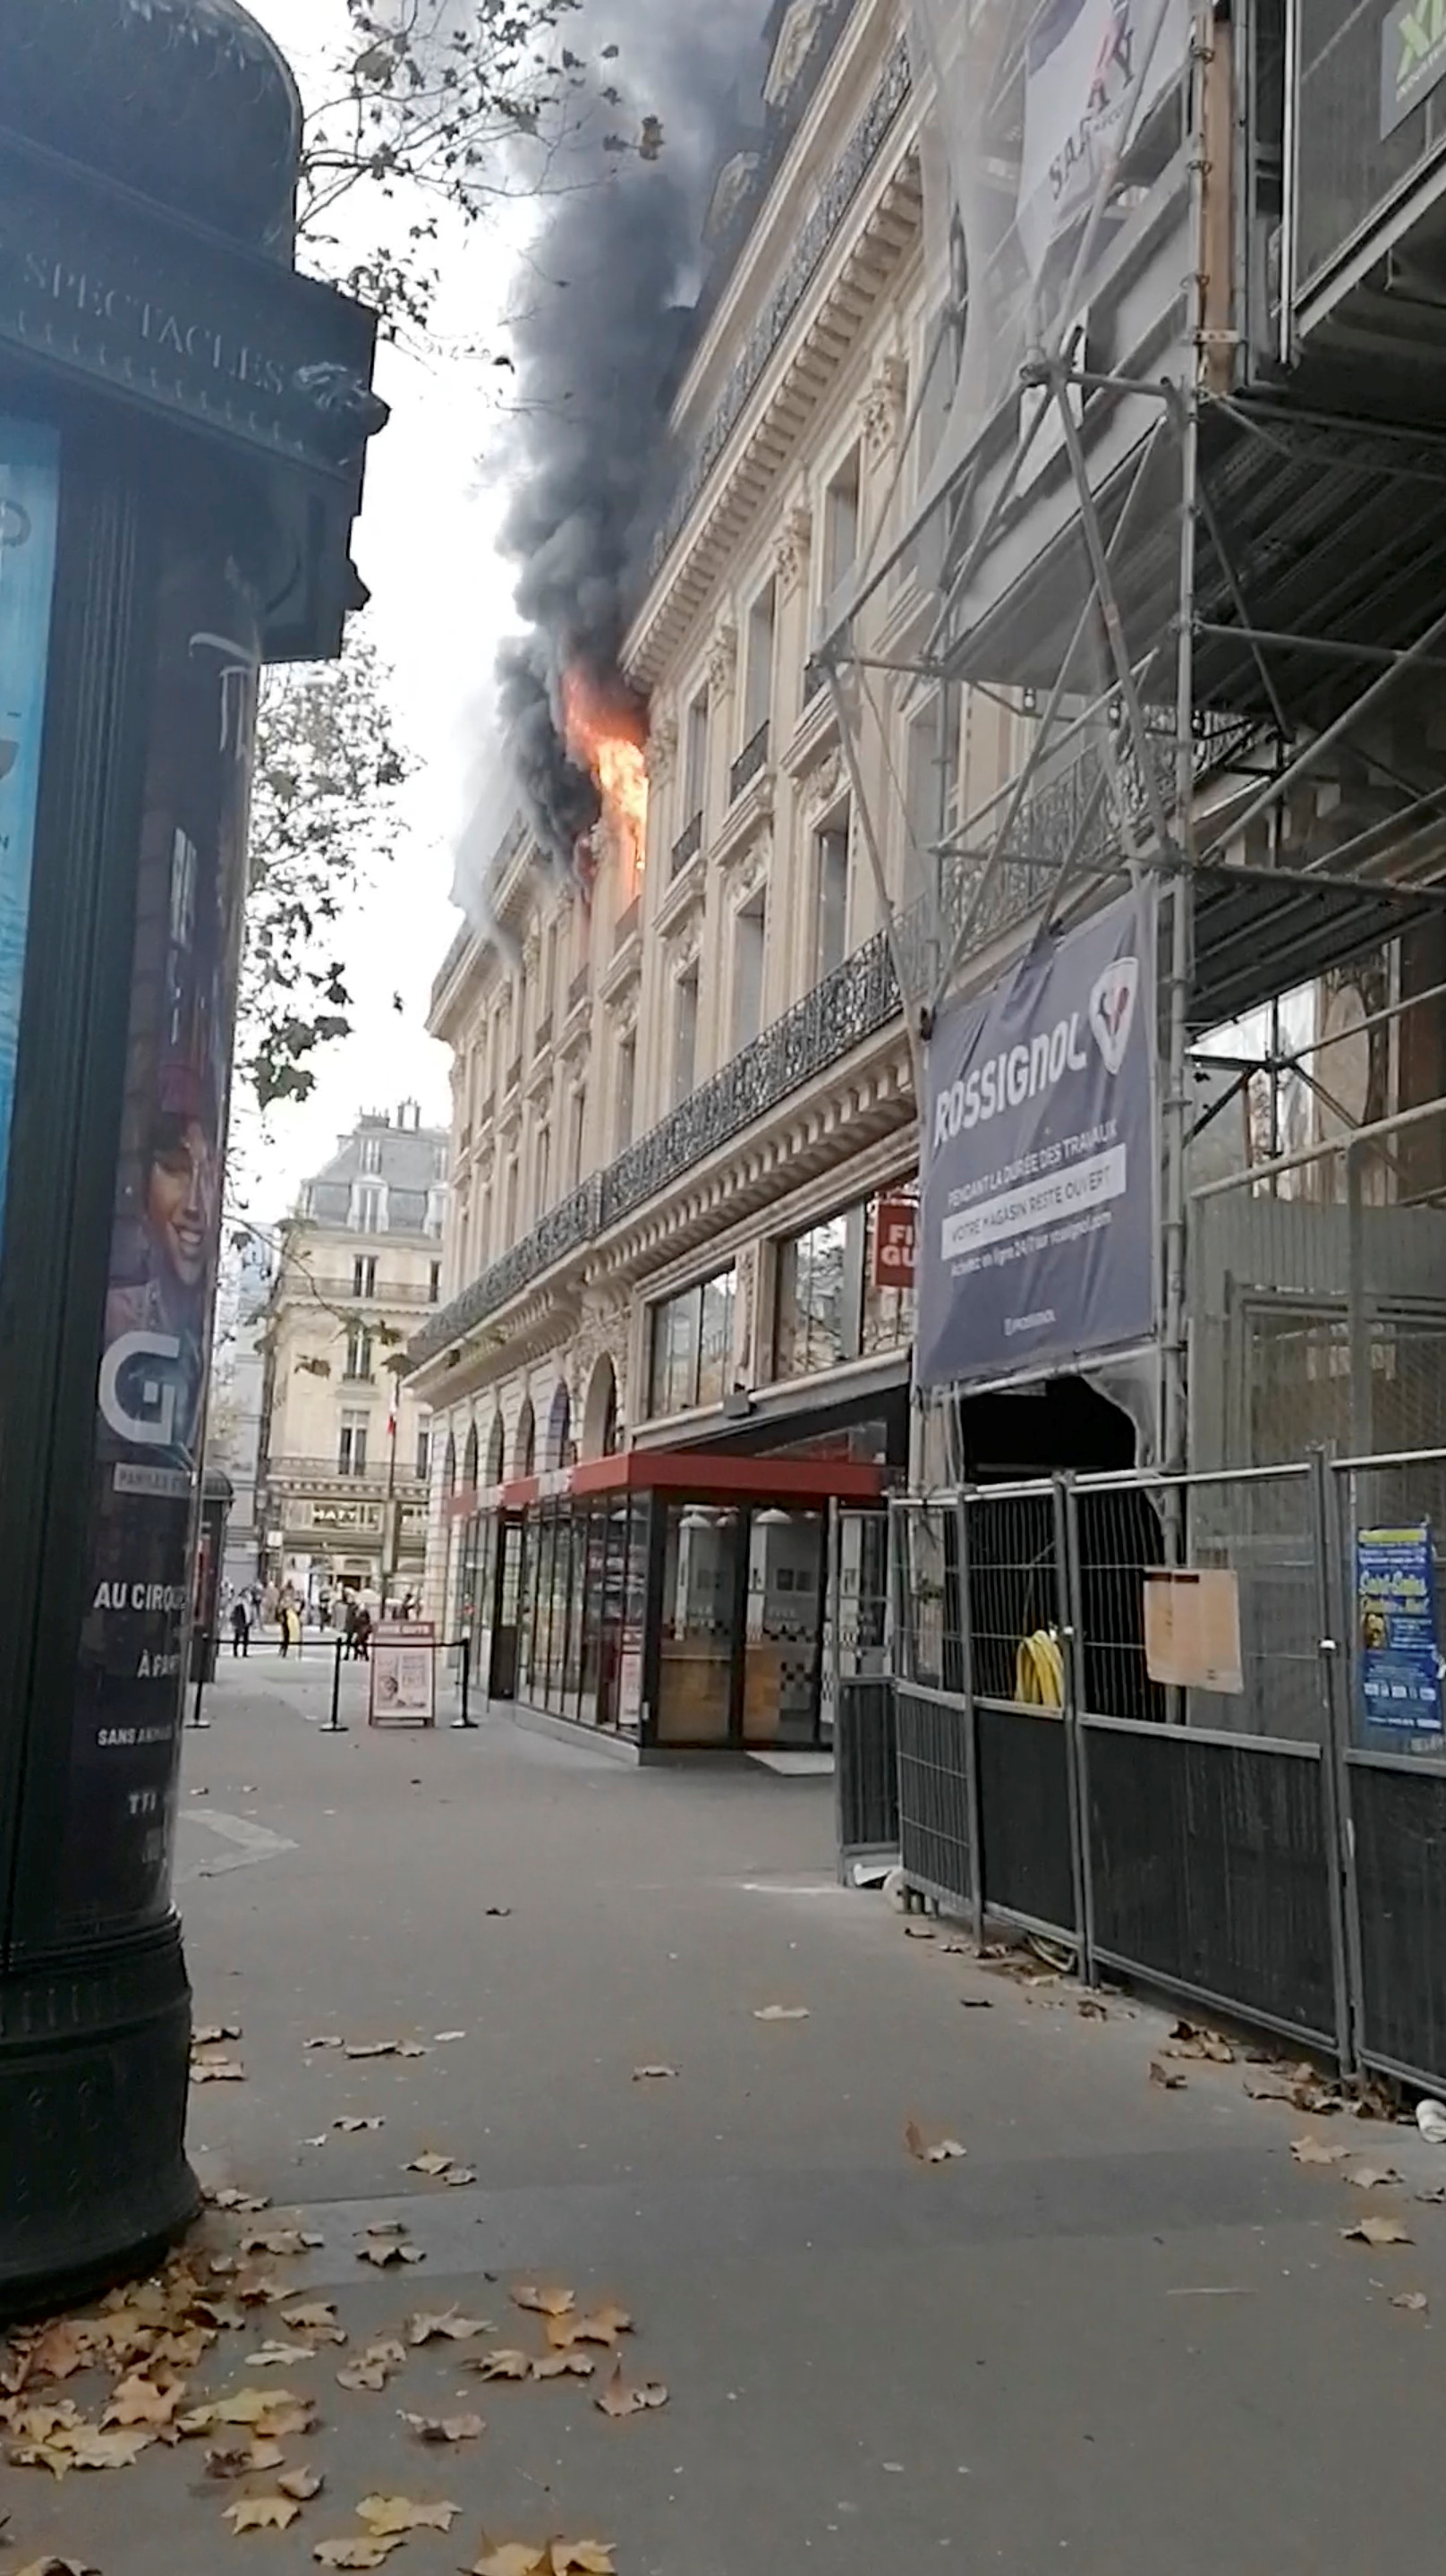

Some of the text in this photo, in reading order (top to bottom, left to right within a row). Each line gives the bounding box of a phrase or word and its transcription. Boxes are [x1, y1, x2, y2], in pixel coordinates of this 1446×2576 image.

[25, 252, 285, 396] SPECTACLES
[934, 1011, 1087, 1148] ROSSIGNOL
[1039, 1143, 1062, 1170] DES
[1062, 1119, 1118, 1159] TRAVAUX
[1029, 1185, 1063, 1210] RESTE
[93, 1582, 185, 1612] AU CIRQ
[98, 1727, 136, 1745] SANS
